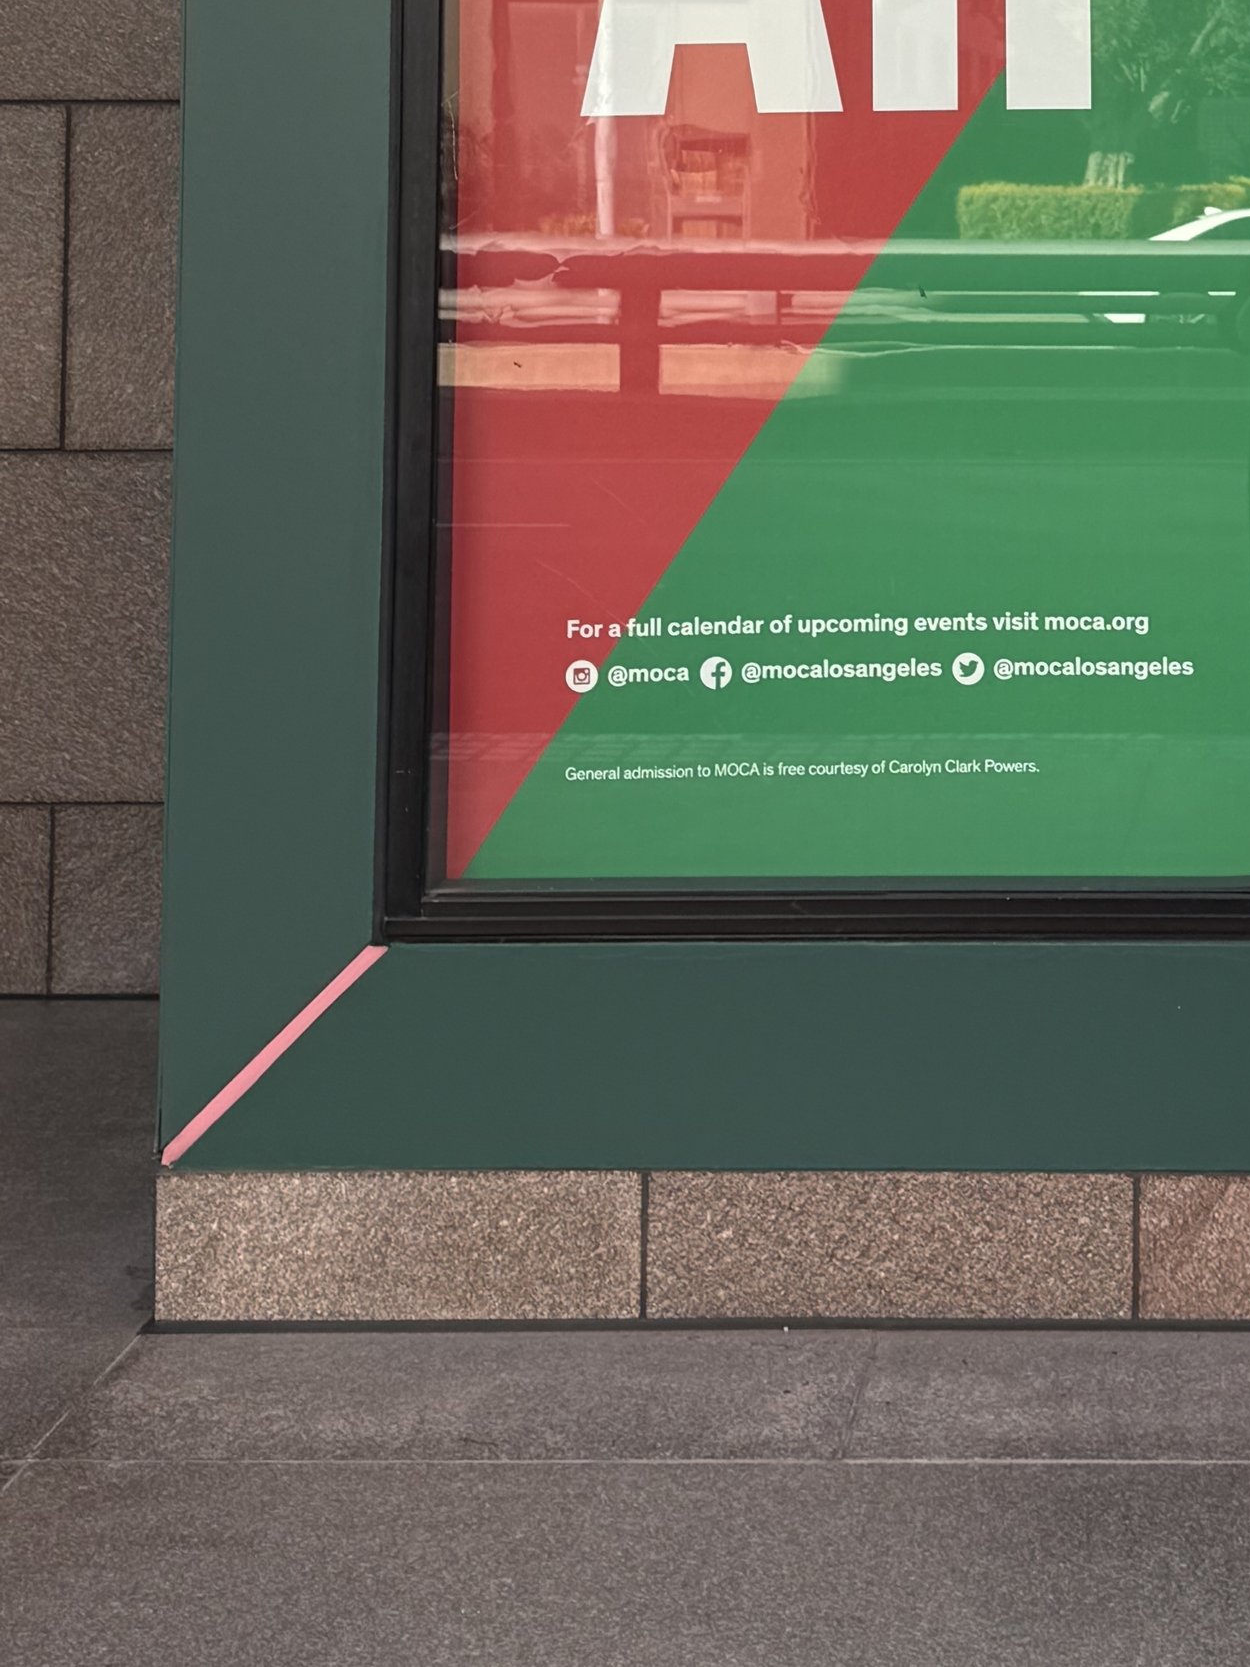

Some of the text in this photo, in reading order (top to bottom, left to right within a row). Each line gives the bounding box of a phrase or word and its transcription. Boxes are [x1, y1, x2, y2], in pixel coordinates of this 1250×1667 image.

[567, 612, 1149, 638] For a full calendar of upcoming events visit moca.org
[608, 657, 1194, 686] @moca @mocalosangeles @mocalosangeles
[565, 758, 1040, 781] General admission to MOCA is free courtesy of Carolyn Clark Powers.
